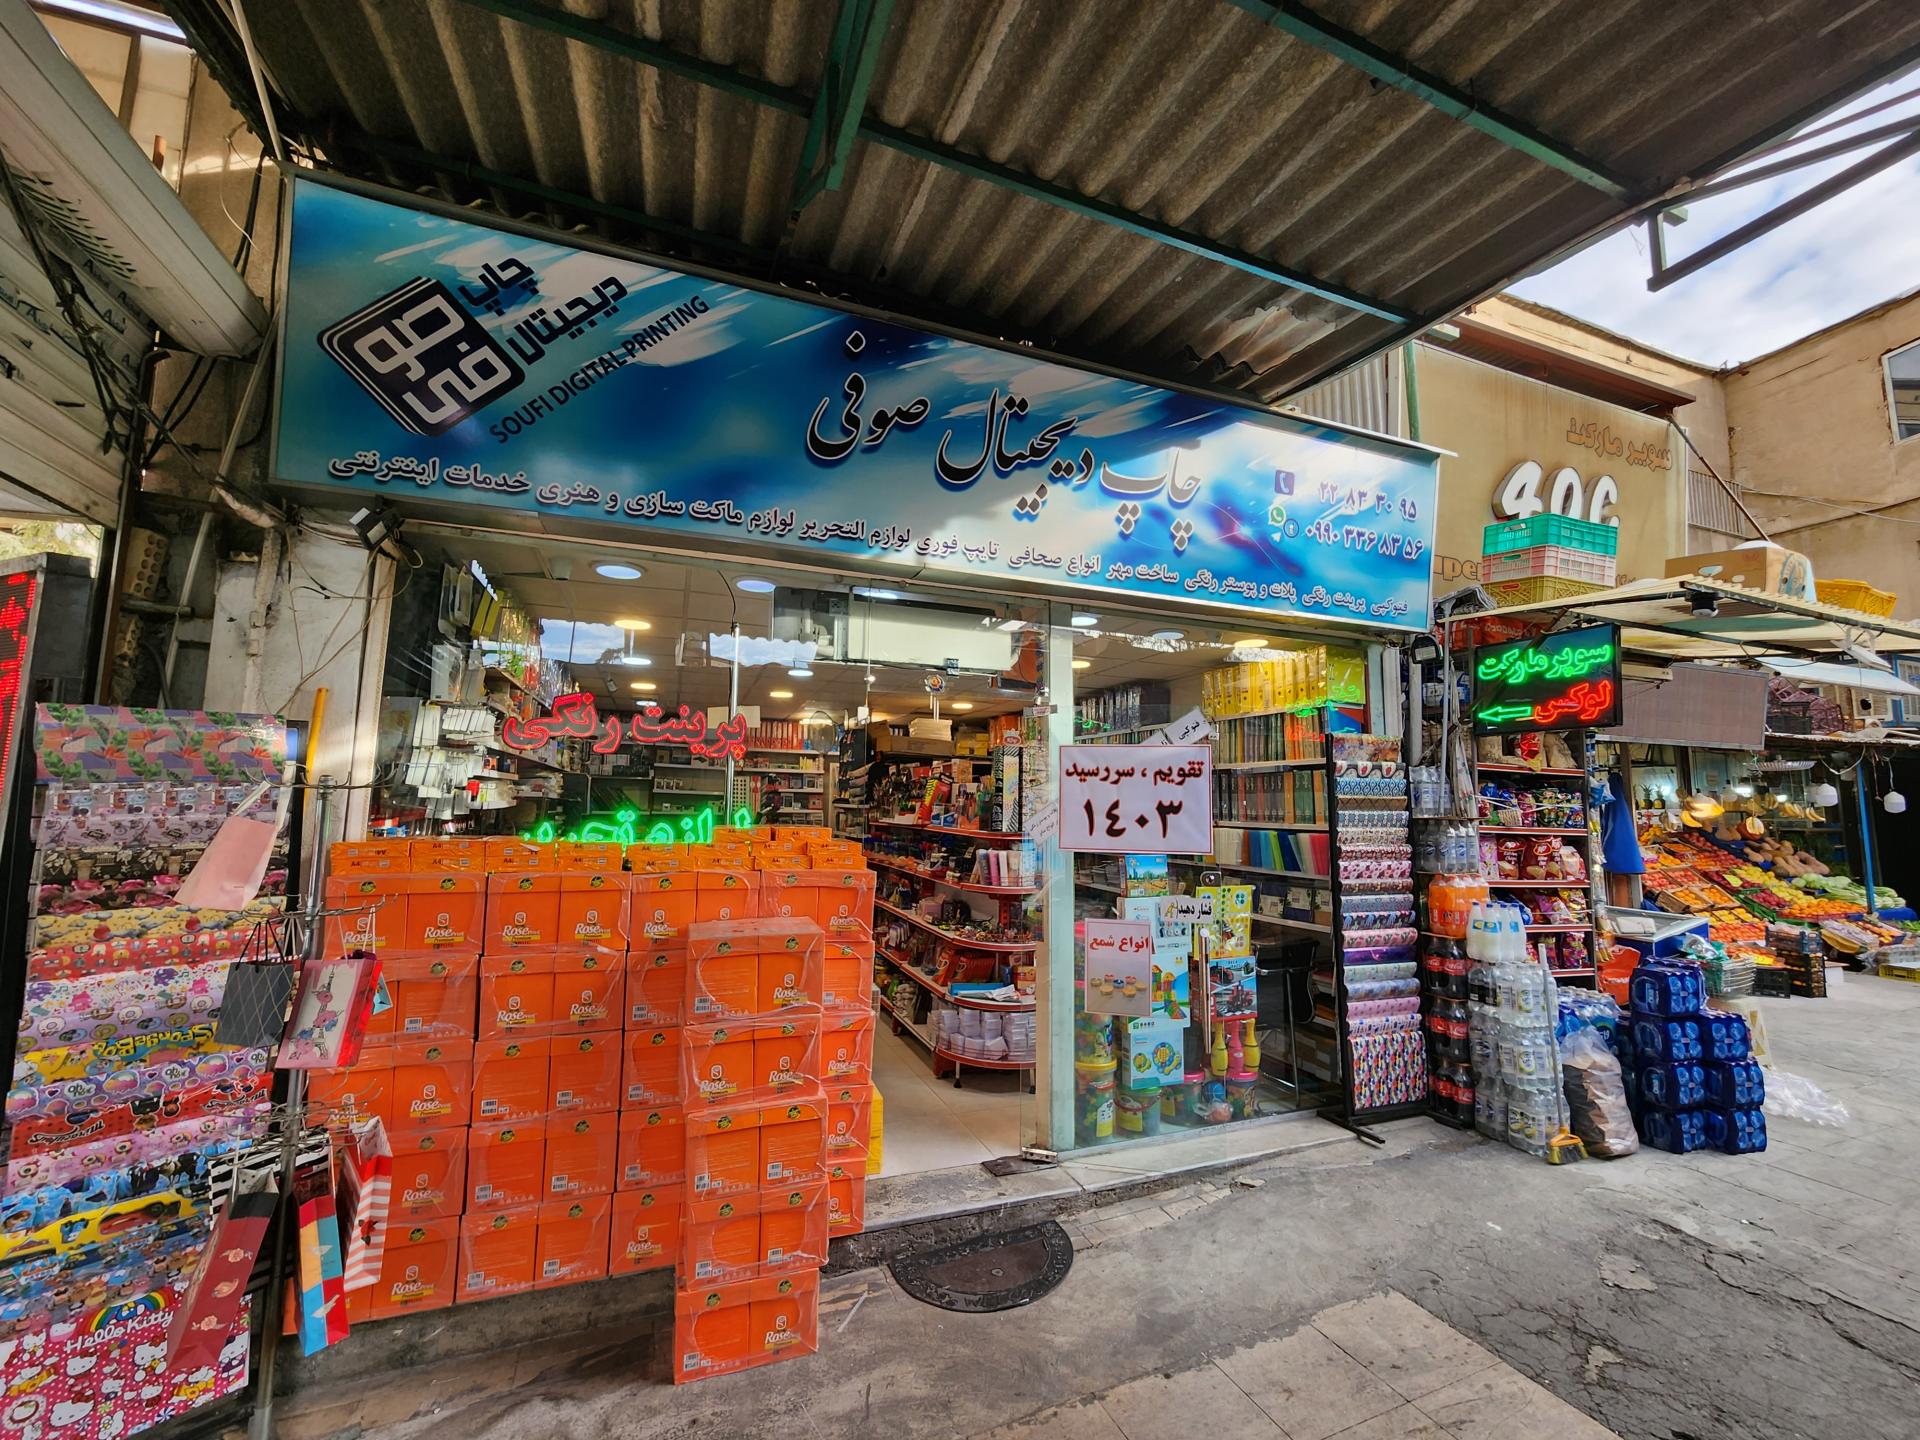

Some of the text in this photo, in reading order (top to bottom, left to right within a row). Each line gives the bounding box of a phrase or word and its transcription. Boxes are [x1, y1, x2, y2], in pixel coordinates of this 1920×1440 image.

[457, 258, 540, 317] چاپ
[506, 276, 628, 366] دیجیتال
[489, 295, 710, 443] SOUFI DIGITAL PRINTING
[807, 331, 1201, 552] چاپ دیجیتال صوفی
[329, 450, 439, 485] اینترنتی
[444, 464, 530, 492] خدمات
[536, 483, 599, 506] هنری
[605, 492, 619, 510] و
[625, 492, 685, 517] سازی
[691, 501, 743, 524] ماکت
[747, 508, 796, 533] لوازم
[800, 521, 865, 542] التحریر
[869, 525, 910, 549] لوازم
[917, 534, 957, 557] فوری
[964, 541, 1000, 562] تایپ
[1009, 546, 1062, 569] صحافی
[1066, 555, 1100, 576] انواع
[1106, 562, 1132, 580] مهر
[1135, 564, 1178, 583] ساخت
[1184, 570, 1217, 591] رنگی
[1221, 577, 1256, 598] پوستر
[1302, 586, 1330, 607] رنگی
[1333, 592, 1365, 611] پرینت
[1371, 599, 1408, 616] فتوکپی
[1533, 679, 1613, 723] لوکس
[503, 692, 747, 760] پرینت رنگی
[1153, 760, 1204, 786] تقویم
[424, 926, 453, 939] Rose
[503, 924, 530, 936] Rose
[575, 922, 600, 934] Rose
[644, 921, 668, 934] Rose
[1089, 934, 1149, 953] انواع شمع
[774, 987, 799, 1000] Rose
[497, 1010, 524, 1024] Rose
[570, 1002, 594, 1015] Rose
[700, 1080, 726, 1092] Rose
[769, 1070, 793, 1082] Rose
[410, 1099, 440, 1112] Rose
[402, 1188, 431, 1201] Rose
[627, 1240, 651, 1252] Rose
[392, 1280, 421, 1296] Rose
[64, 1310, 174, 1352] Hello Kitty
[764, 1330, 791, 1345] Rose
